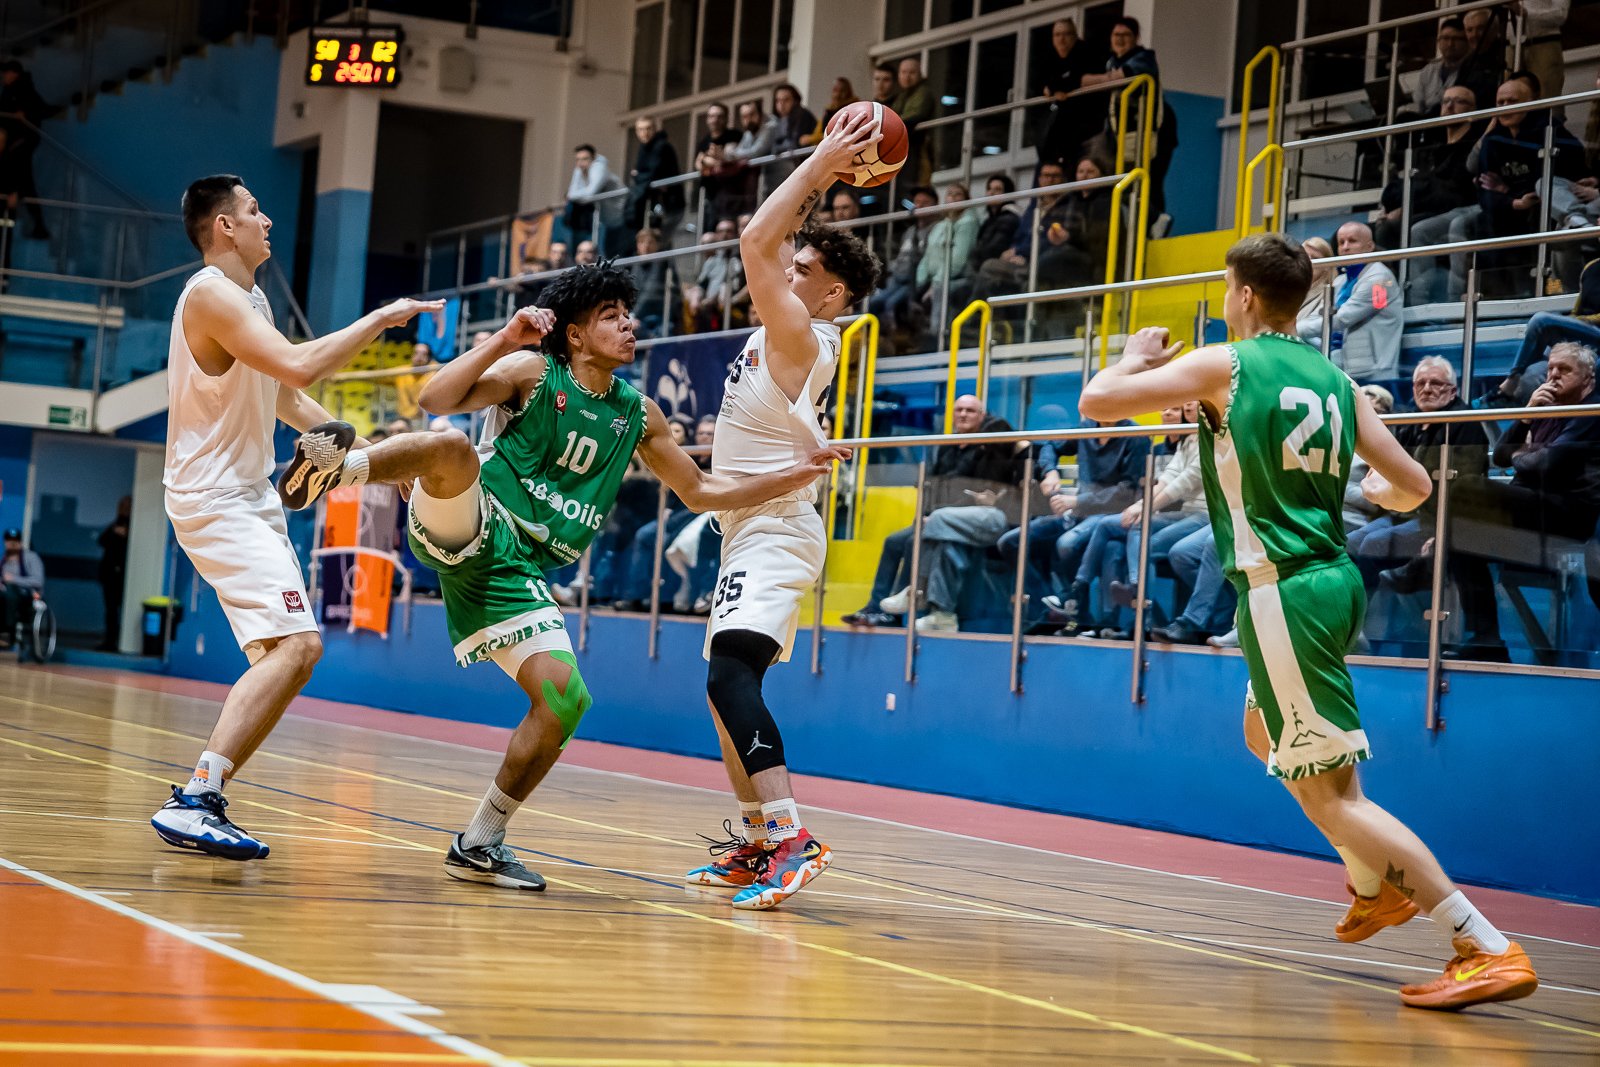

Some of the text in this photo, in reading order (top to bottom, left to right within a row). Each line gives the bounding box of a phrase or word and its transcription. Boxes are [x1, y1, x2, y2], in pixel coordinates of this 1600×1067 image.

[372, 42, 397, 62] 62
[387, 67, 396, 83] 1
[1279, 386, 1343, 478] 21
[556, 431, 598, 474] 10
[562, 499, 603, 531] Oils
[715, 571, 747, 608] 35
